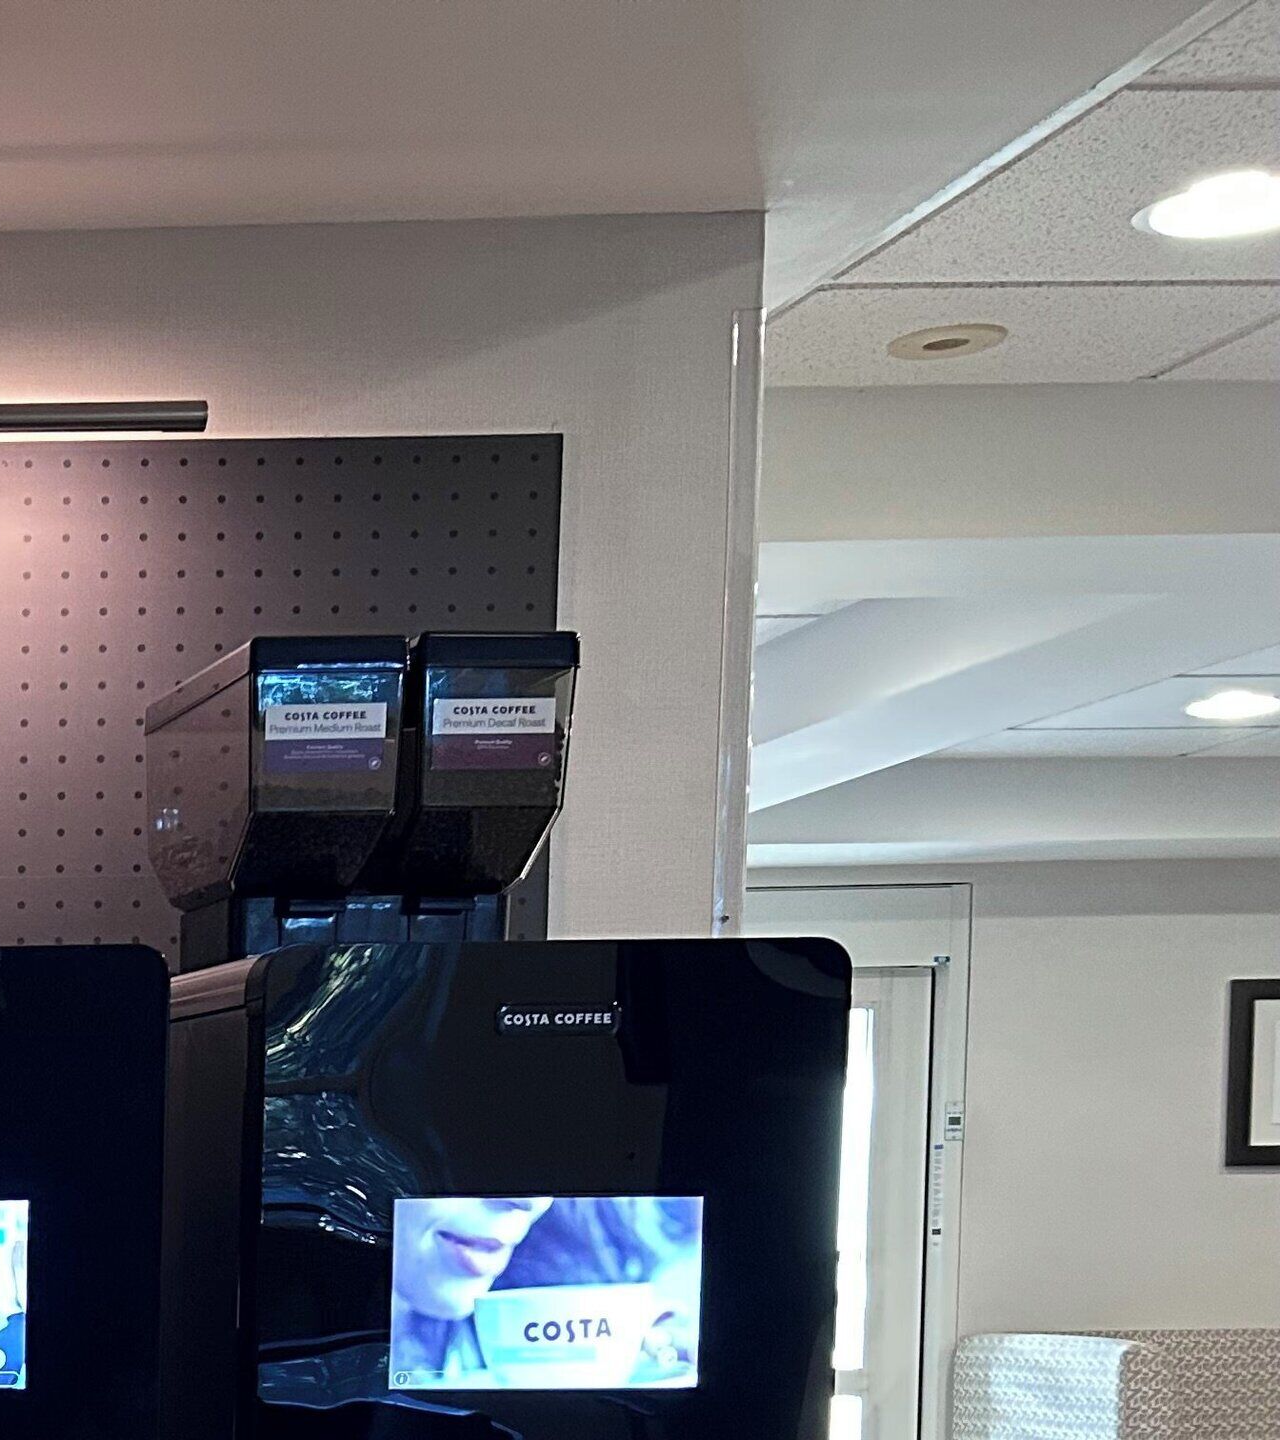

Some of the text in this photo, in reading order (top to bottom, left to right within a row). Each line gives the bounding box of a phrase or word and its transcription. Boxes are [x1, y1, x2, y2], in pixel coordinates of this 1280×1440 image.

[284, 711, 367, 721] COSTA COFFEE
[453, 705, 536, 716] COSTA COFFEE
[269, 723, 382, 734] Premium Medium Roast
[443, 718, 546, 729] Premium Decaf Roast
[503, 1013, 612, 1026] COSTA COFFEE
[524, 1317, 612, 1343] COSTA
